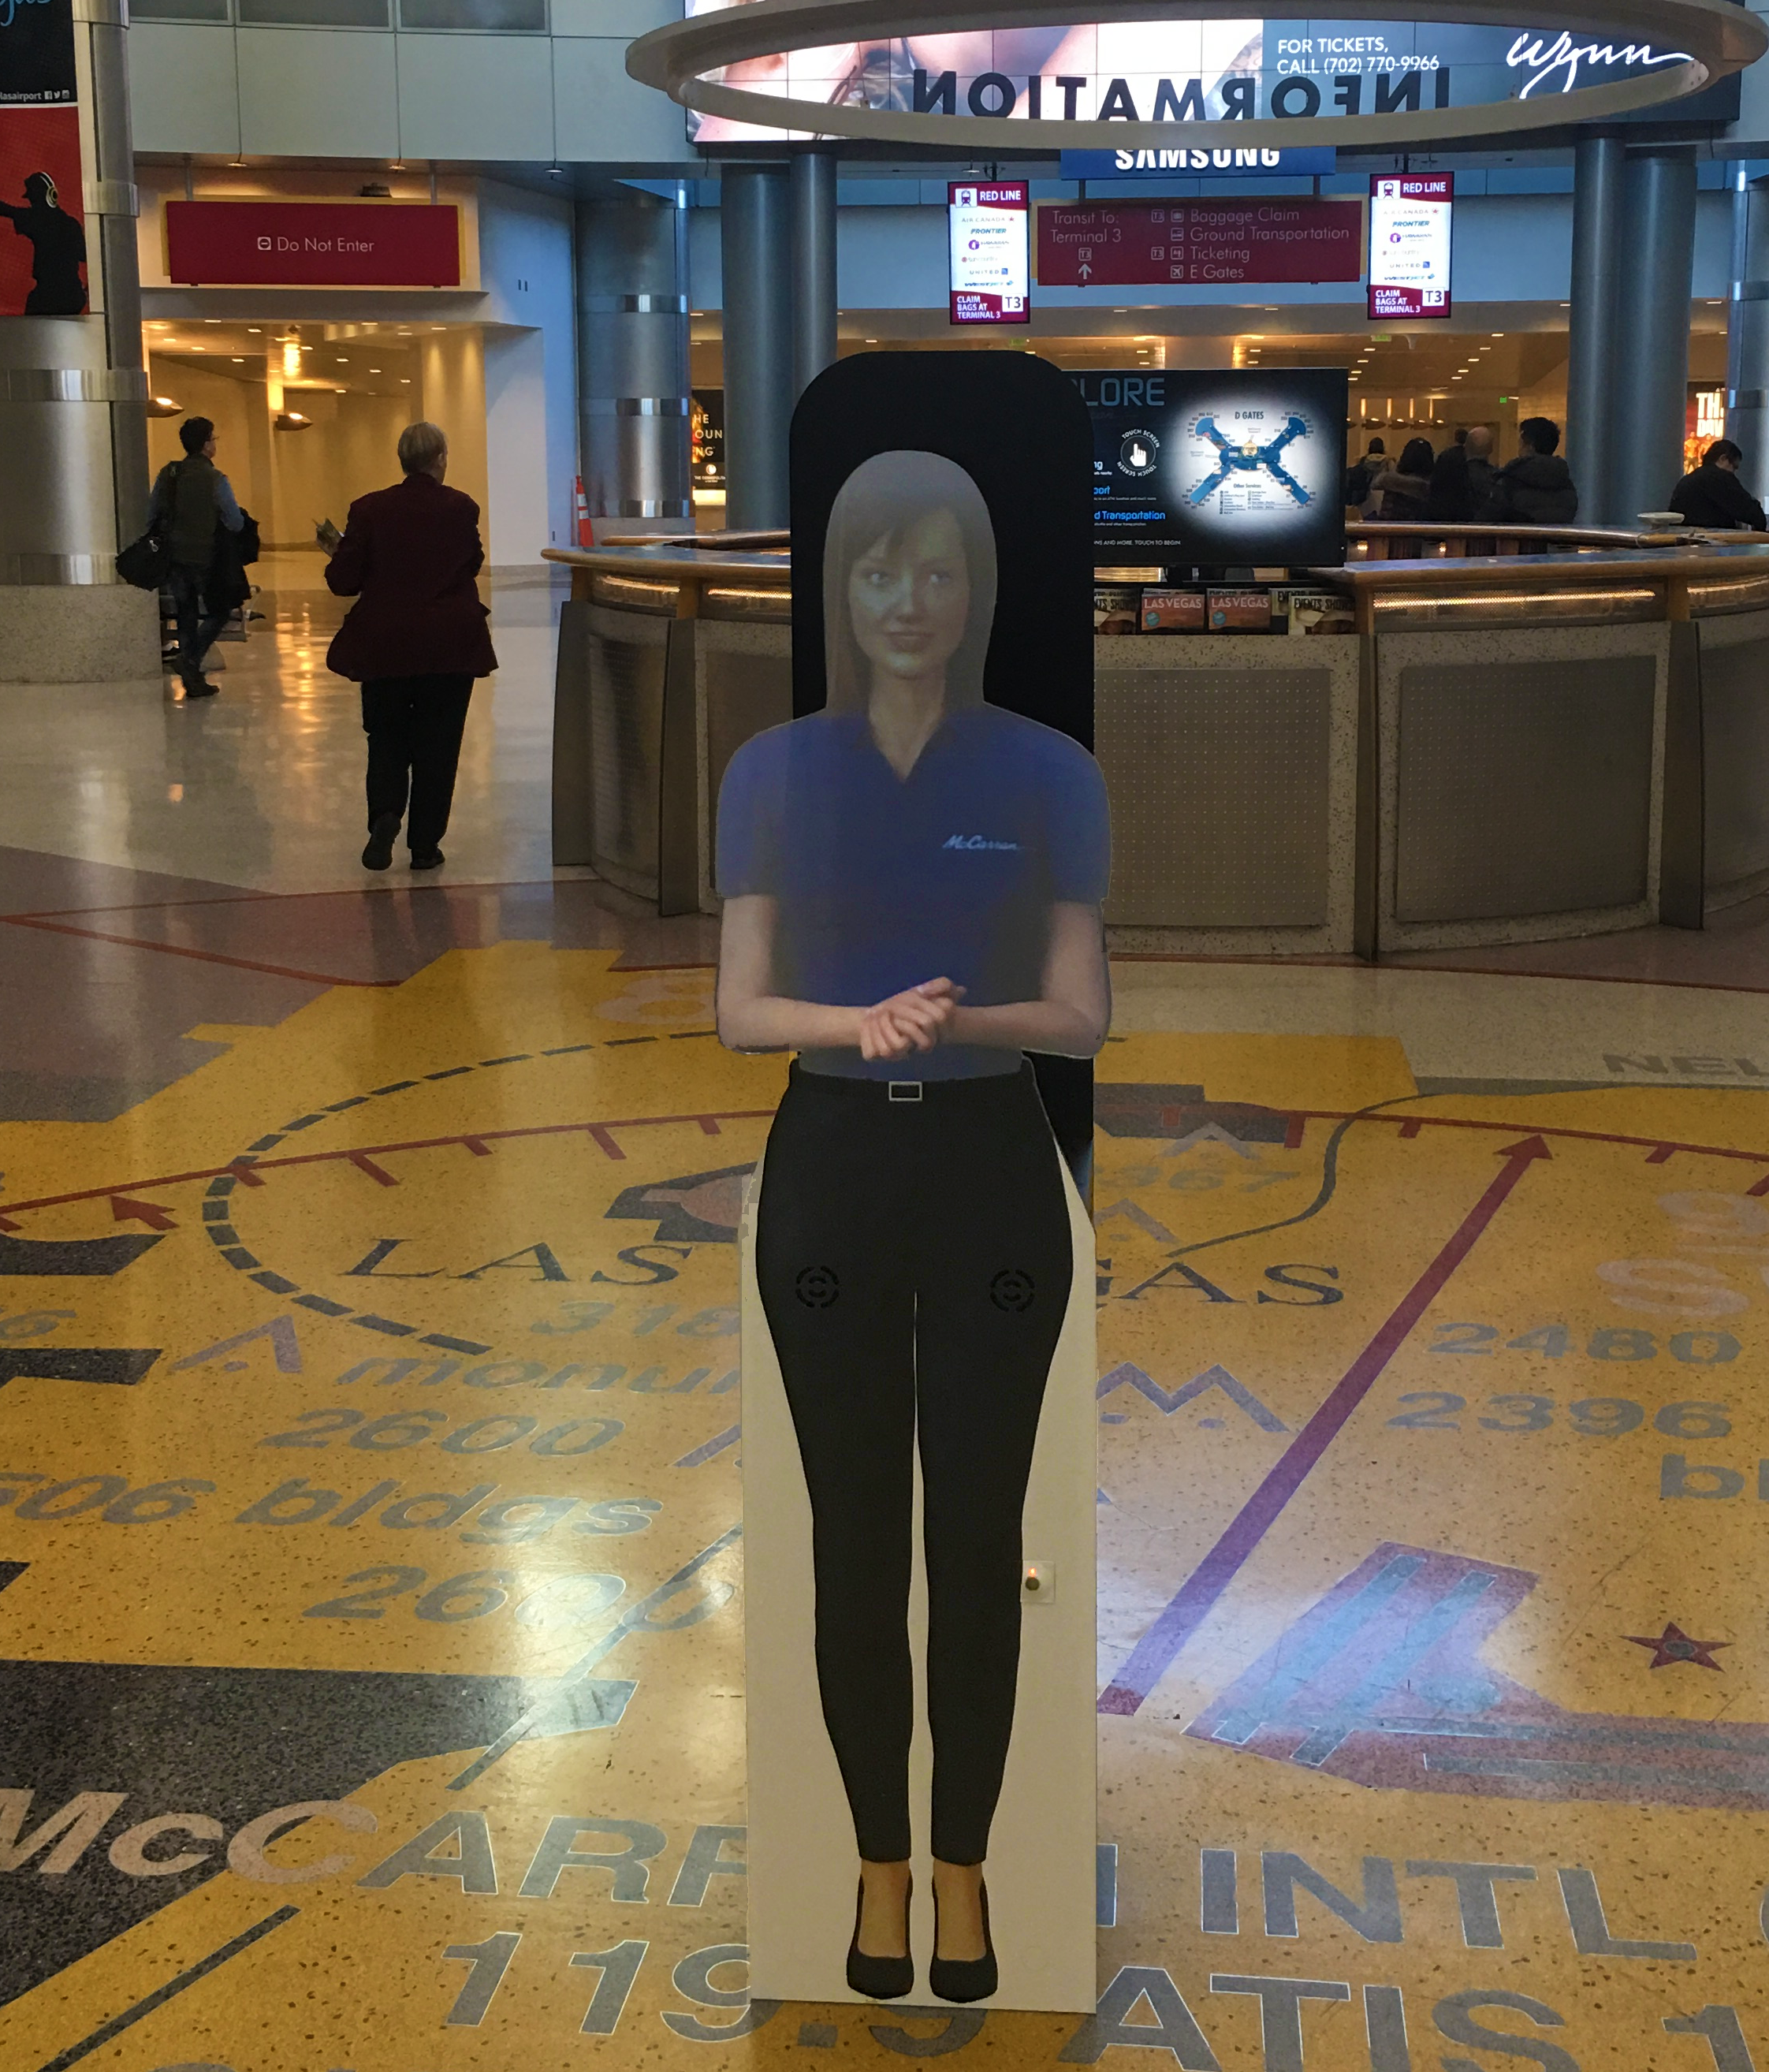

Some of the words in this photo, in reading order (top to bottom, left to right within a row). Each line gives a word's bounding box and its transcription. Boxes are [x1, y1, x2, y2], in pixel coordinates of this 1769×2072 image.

[1278, 39, 1313, 54] FOR
[1317, 36, 1388, 53] TICKETS,
[1277, 58, 1320, 74] CALL
[1324, 58, 1362, 74] (702)
[1367, 55, 1439, 72] 770-9966
[1403, 182, 1422, 193] RED
[1425, 181, 1446, 192] LINE
[980, 191, 998, 201] RED
[1000, 190, 1021, 200] LINE
[1052, 211, 1096, 225] Transit
[1190, 209, 1253, 226] Baggage
[1257, 207, 1300, 222] Claim
[1051, 229, 1107, 244] Terminal
[1112, 229, 1122, 243] 3
[1190, 228, 1244, 242] Ground
[1250, 226, 1350, 243] Transportation
[277, 237, 300, 252] Do
[304, 237, 332, 252] Not
[337, 237, 374, 252] Enter
[1190, 246, 1250, 263] Ticketing
[1190, 265, 1197, 278] E
[1203, 264, 1245, 278] Gates
[1005, 296, 1021, 308] T3
[1425, 290, 1442, 303] T3
[1375, 305, 1414, 314] TERMINAL
[1080, 378, 1165, 406] LORE
[693, 414, 709, 423] HE
[1242, 411, 1264, 419] GATES
[1102, 511, 1166, 521] Transportation
[1145, 598, 1164, 609] LAS
[1166, 598, 1202, 609] VEGAS
[1212, 597, 1231, 608] LAS
[1232, 597, 1268, 608] VEGAS
[338, 1238, 693, 1286] LAS
[1423, 1322, 1742, 1365] 2480
[1387, 1391, 1733, 1440] 2396
[257, 1409, 626, 1456] 2600
[236, 1478, 665, 1545] bldgs
[302, 1565, 736, 1633] 2600
[1201, 1847, 1698, 1962] INTL
[1056, 1965, 1582, 2072] ATIS
